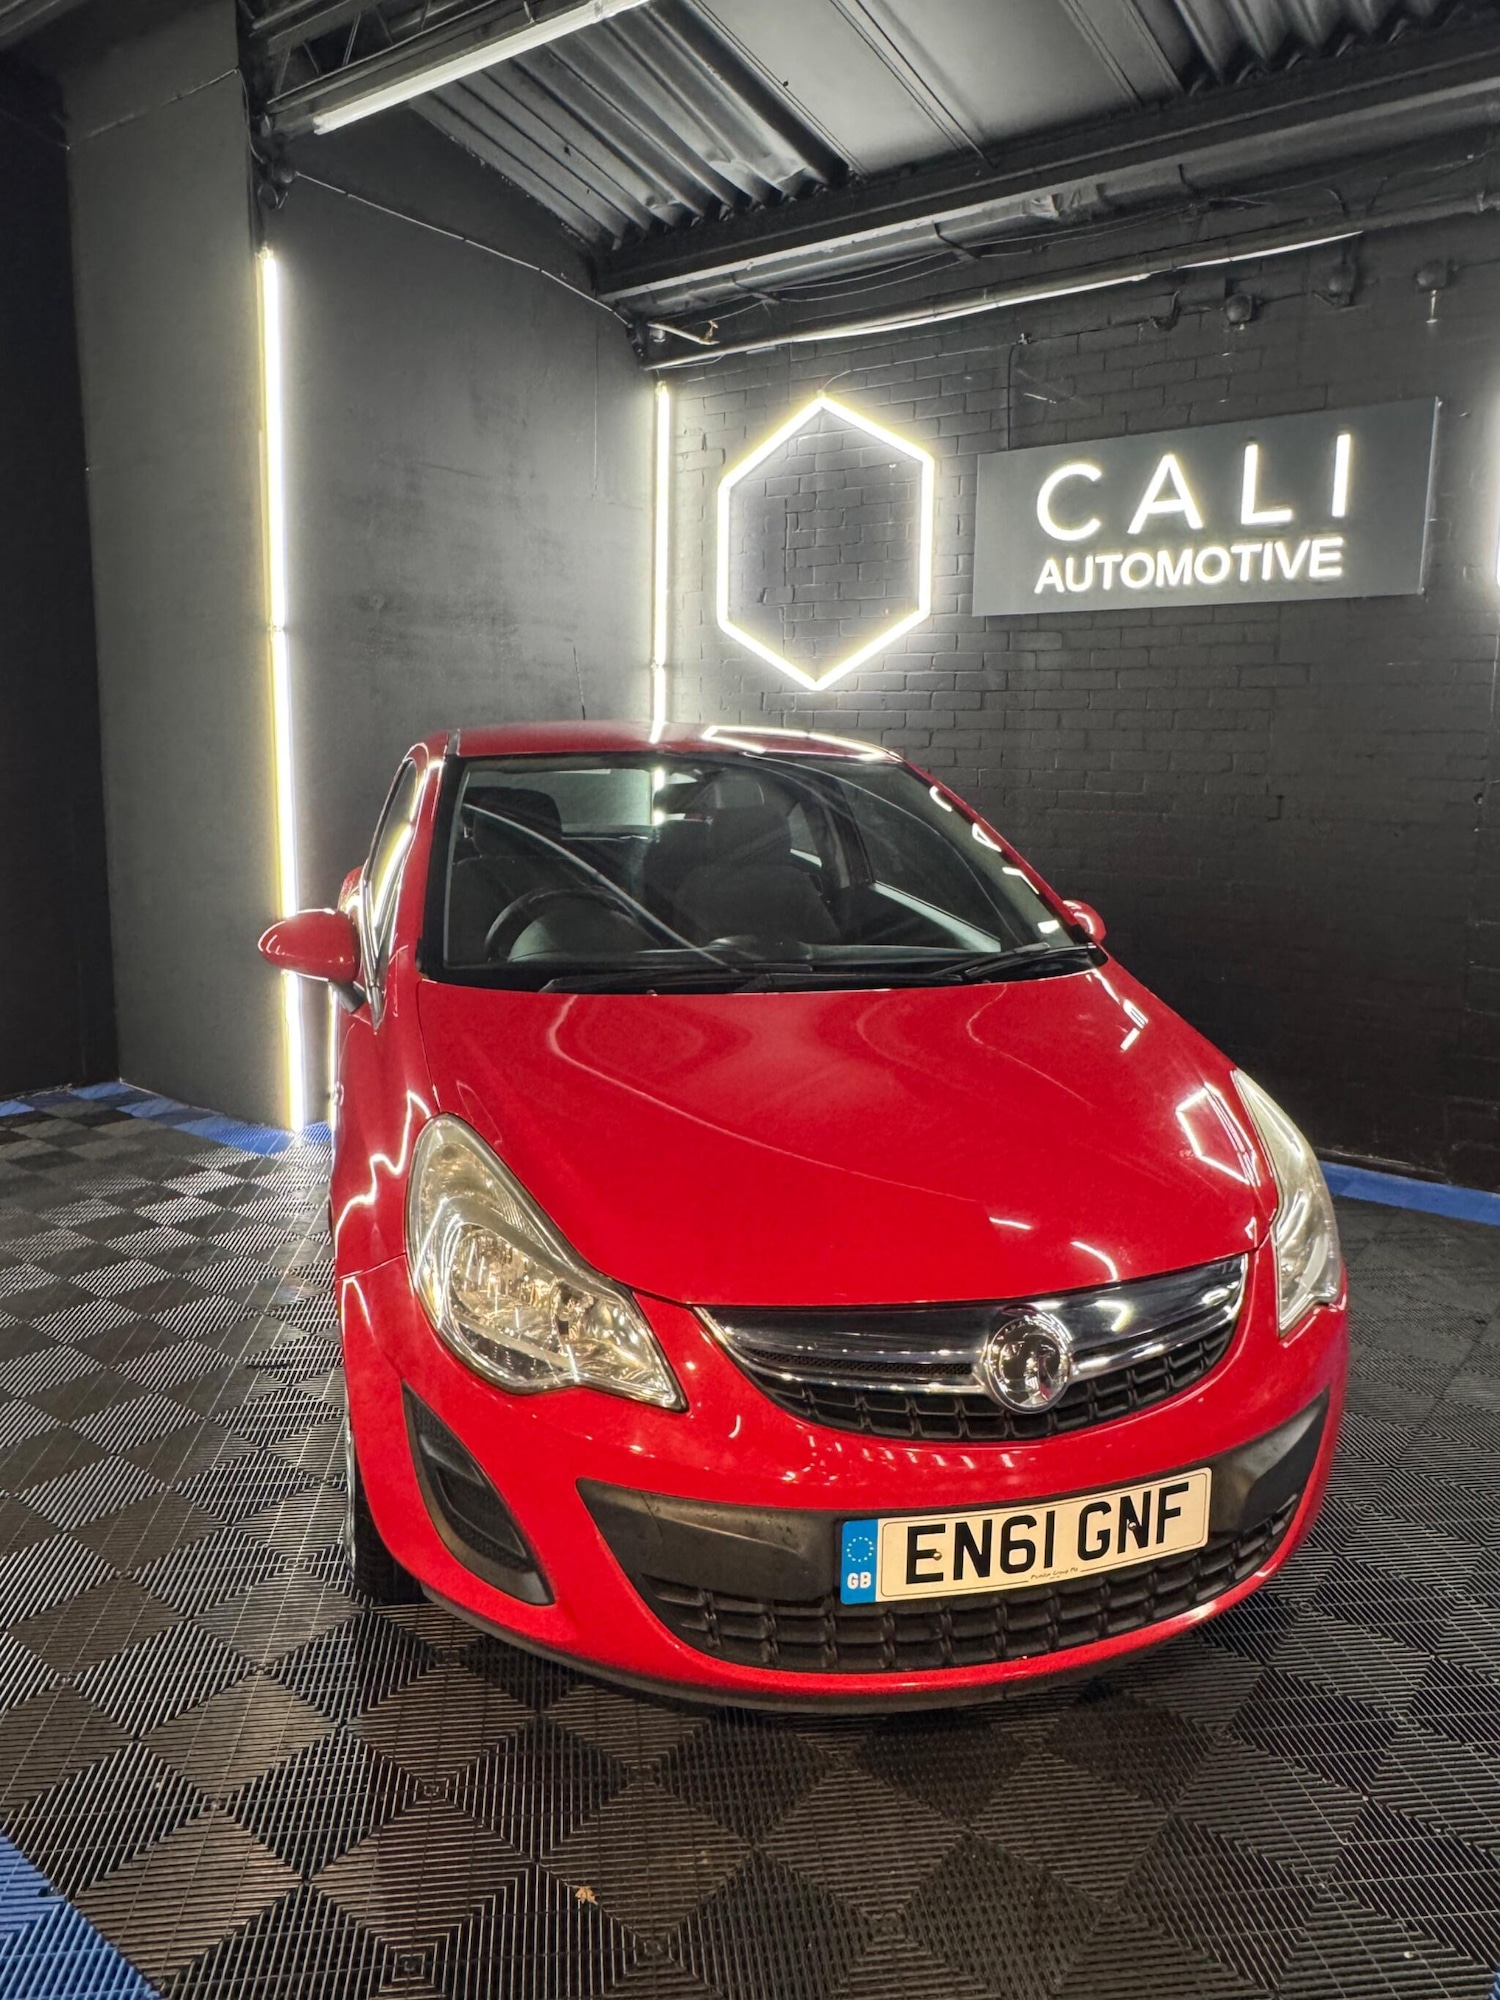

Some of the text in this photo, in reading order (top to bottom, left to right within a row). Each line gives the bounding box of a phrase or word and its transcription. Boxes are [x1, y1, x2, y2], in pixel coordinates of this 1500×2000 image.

[1036, 432, 1351, 541] CALI
[1033, 536, 1345, 595] AUTOMOTIVE
[905, 1482, 1190, 1585] EN61 GNF
[847, 1571, 872, 1590] GB
